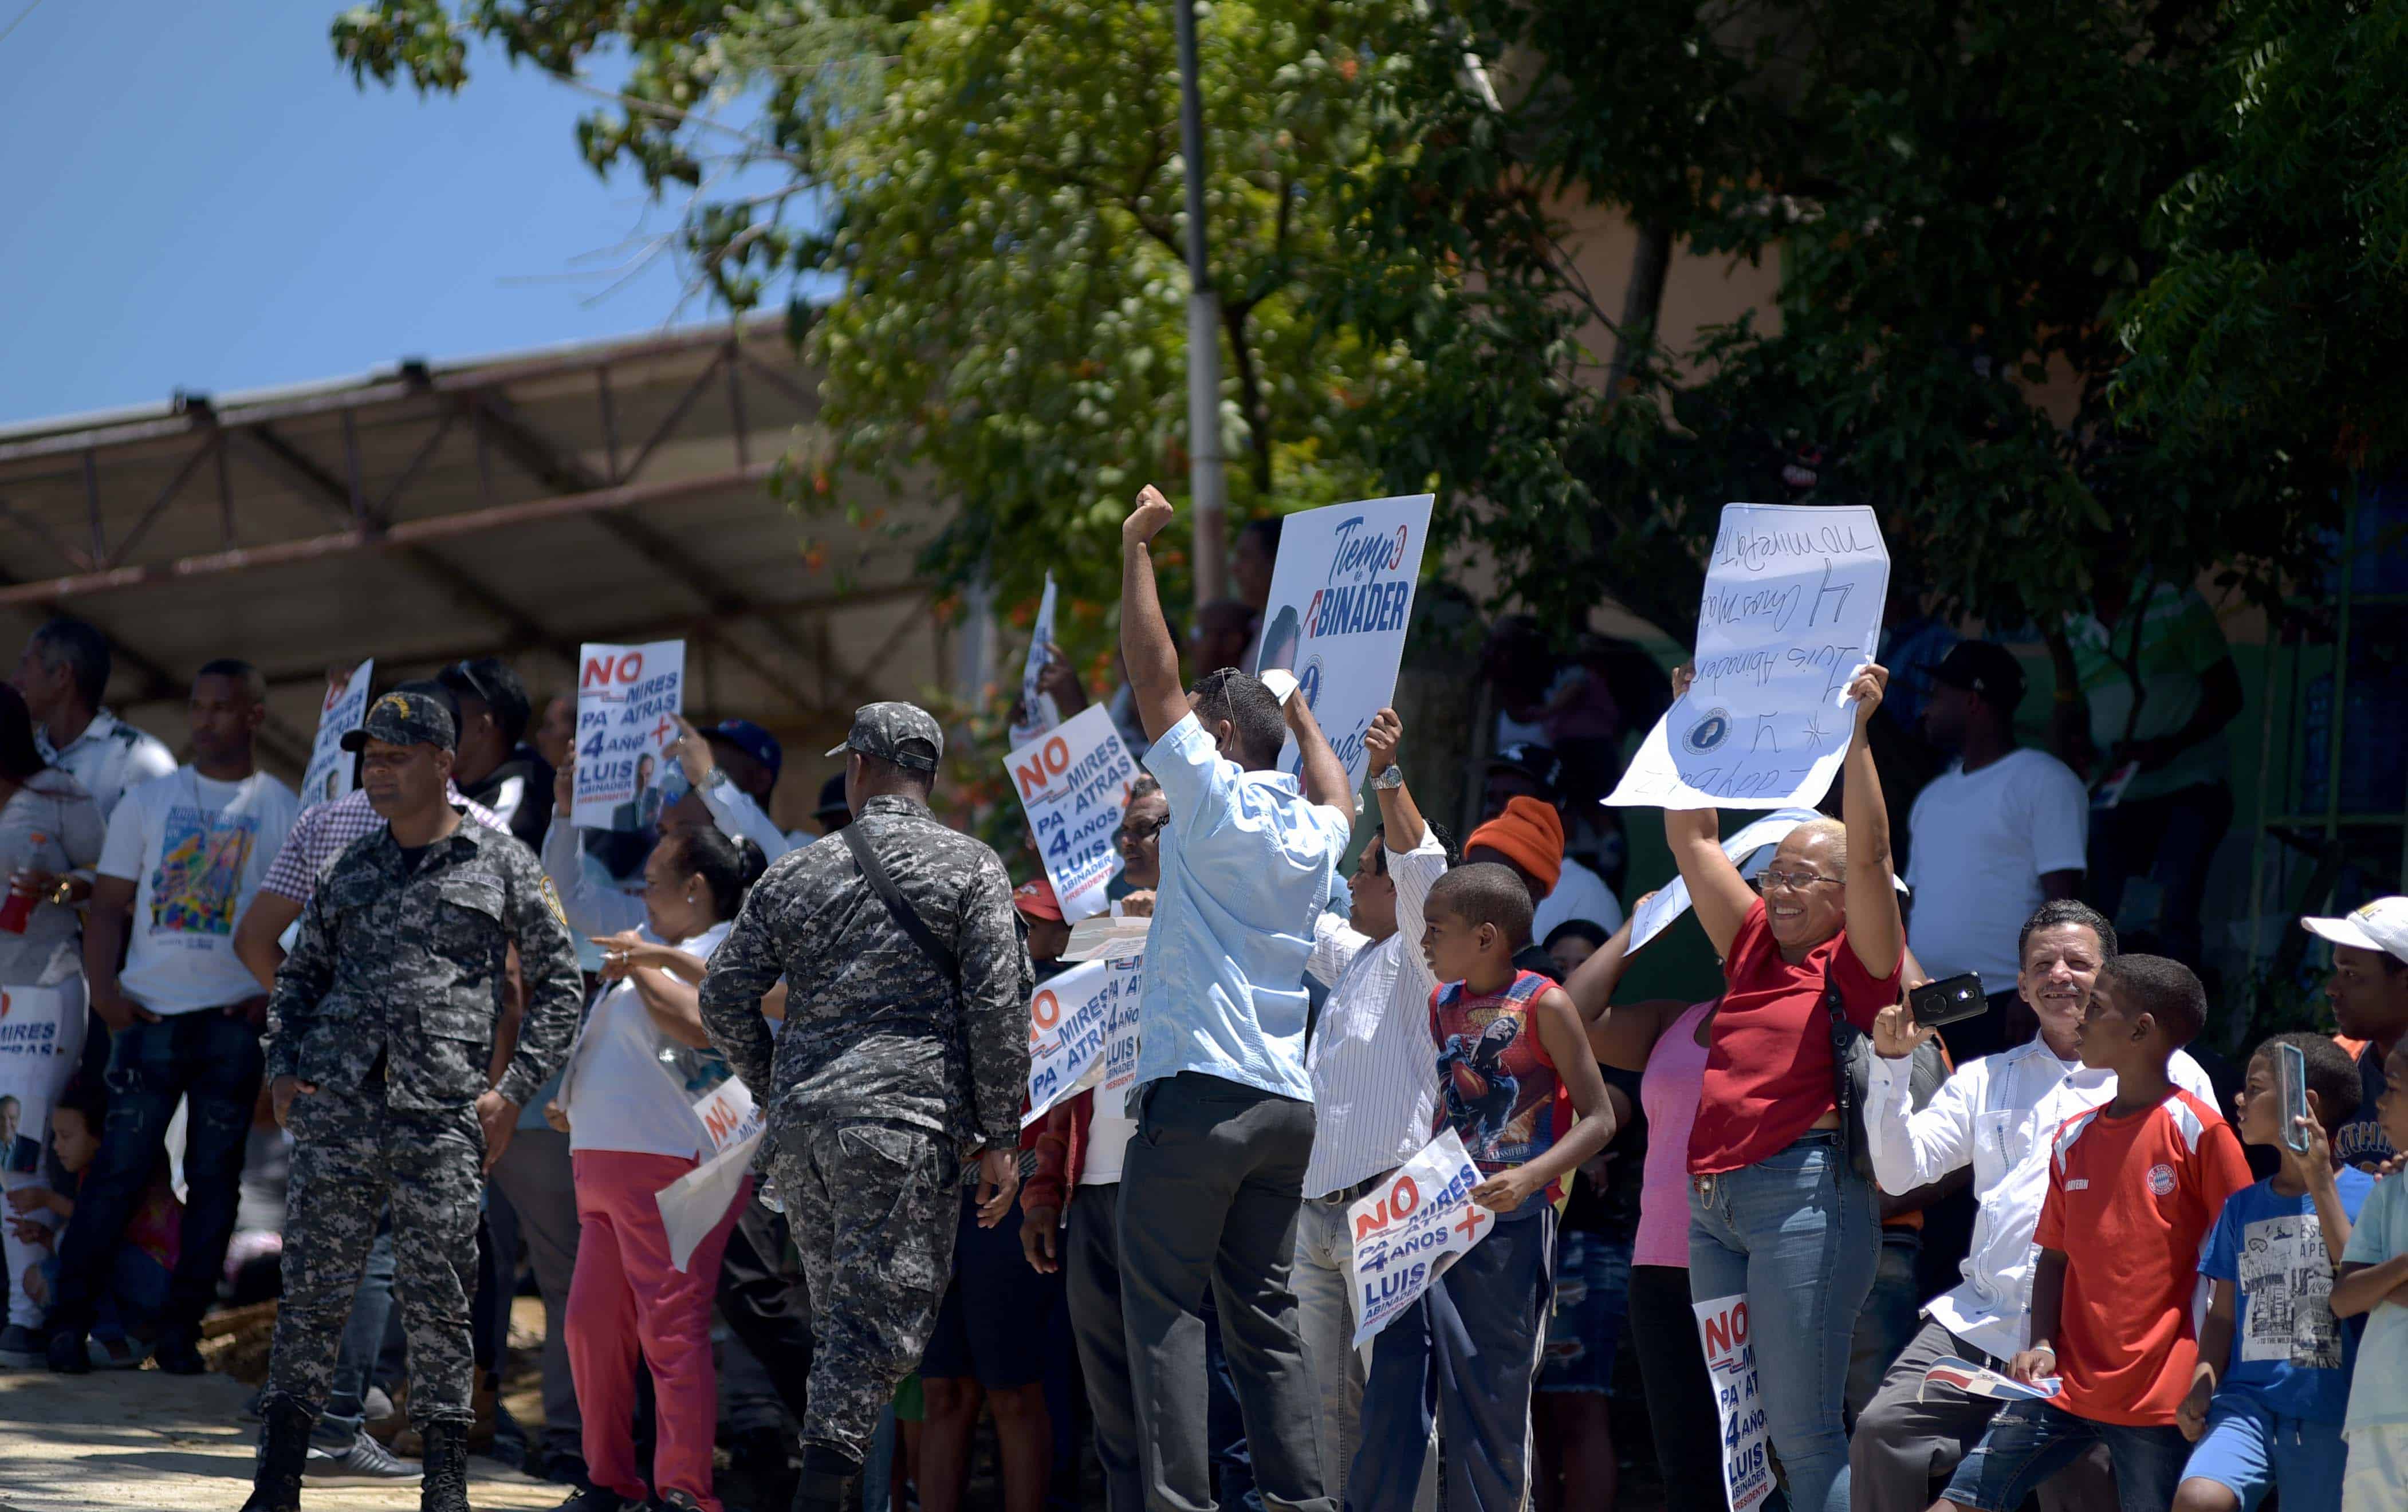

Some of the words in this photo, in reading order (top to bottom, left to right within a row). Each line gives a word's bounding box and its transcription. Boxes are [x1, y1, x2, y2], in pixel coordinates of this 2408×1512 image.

[1328, 517, 1407, 591] Tiempo
[1301, 581, 1408, 639] ABINADER
[1809, 558, 1854, 627] 4
[582, 652, 642, 688] NO
[626, 672, 678, 703] MIRES
[1693, 652, 1779, 695] Abinader
[581, 731, 604, 757] 4
[1067, 735, 1120, 791] MIRES
[579, 761, 632, 783] LUIS
[1016, 736, 1069, 800] NO
[1076, 755, 1131, 816] ATRAS
[1048, 829, 1070, 858] 4
[1055, 838, 1106, 884] LUIS
[1062, 855, 1112, 895] ABINADER
[1107, 1003, 1116, 1037] 4
[1106, 1036, 1134, 1069] LUIS
[1106, 1059, 1135, 1081] ABINADER
[705, 1096, 738, 1146] NO
[1487, 1145, 1528, 1160] CLASSIFIED
[1356, 1176, 1419, 1242] NO
[1409, 1164, 1477, 1225] MIRES
[1360, 1250, 1388, 1273] 4
[1365, 1283, 1422, 1321] ABINADER
[1366, 1262, 1426, 1308] LUIS
[1705, 1302, 1748, 1361] NO
[1725, 1411, 1741, 1450] 4
[1728, 1442, 1764, 1487] LUIS
[1732, 1467, 1766, 1501] ABINADER
